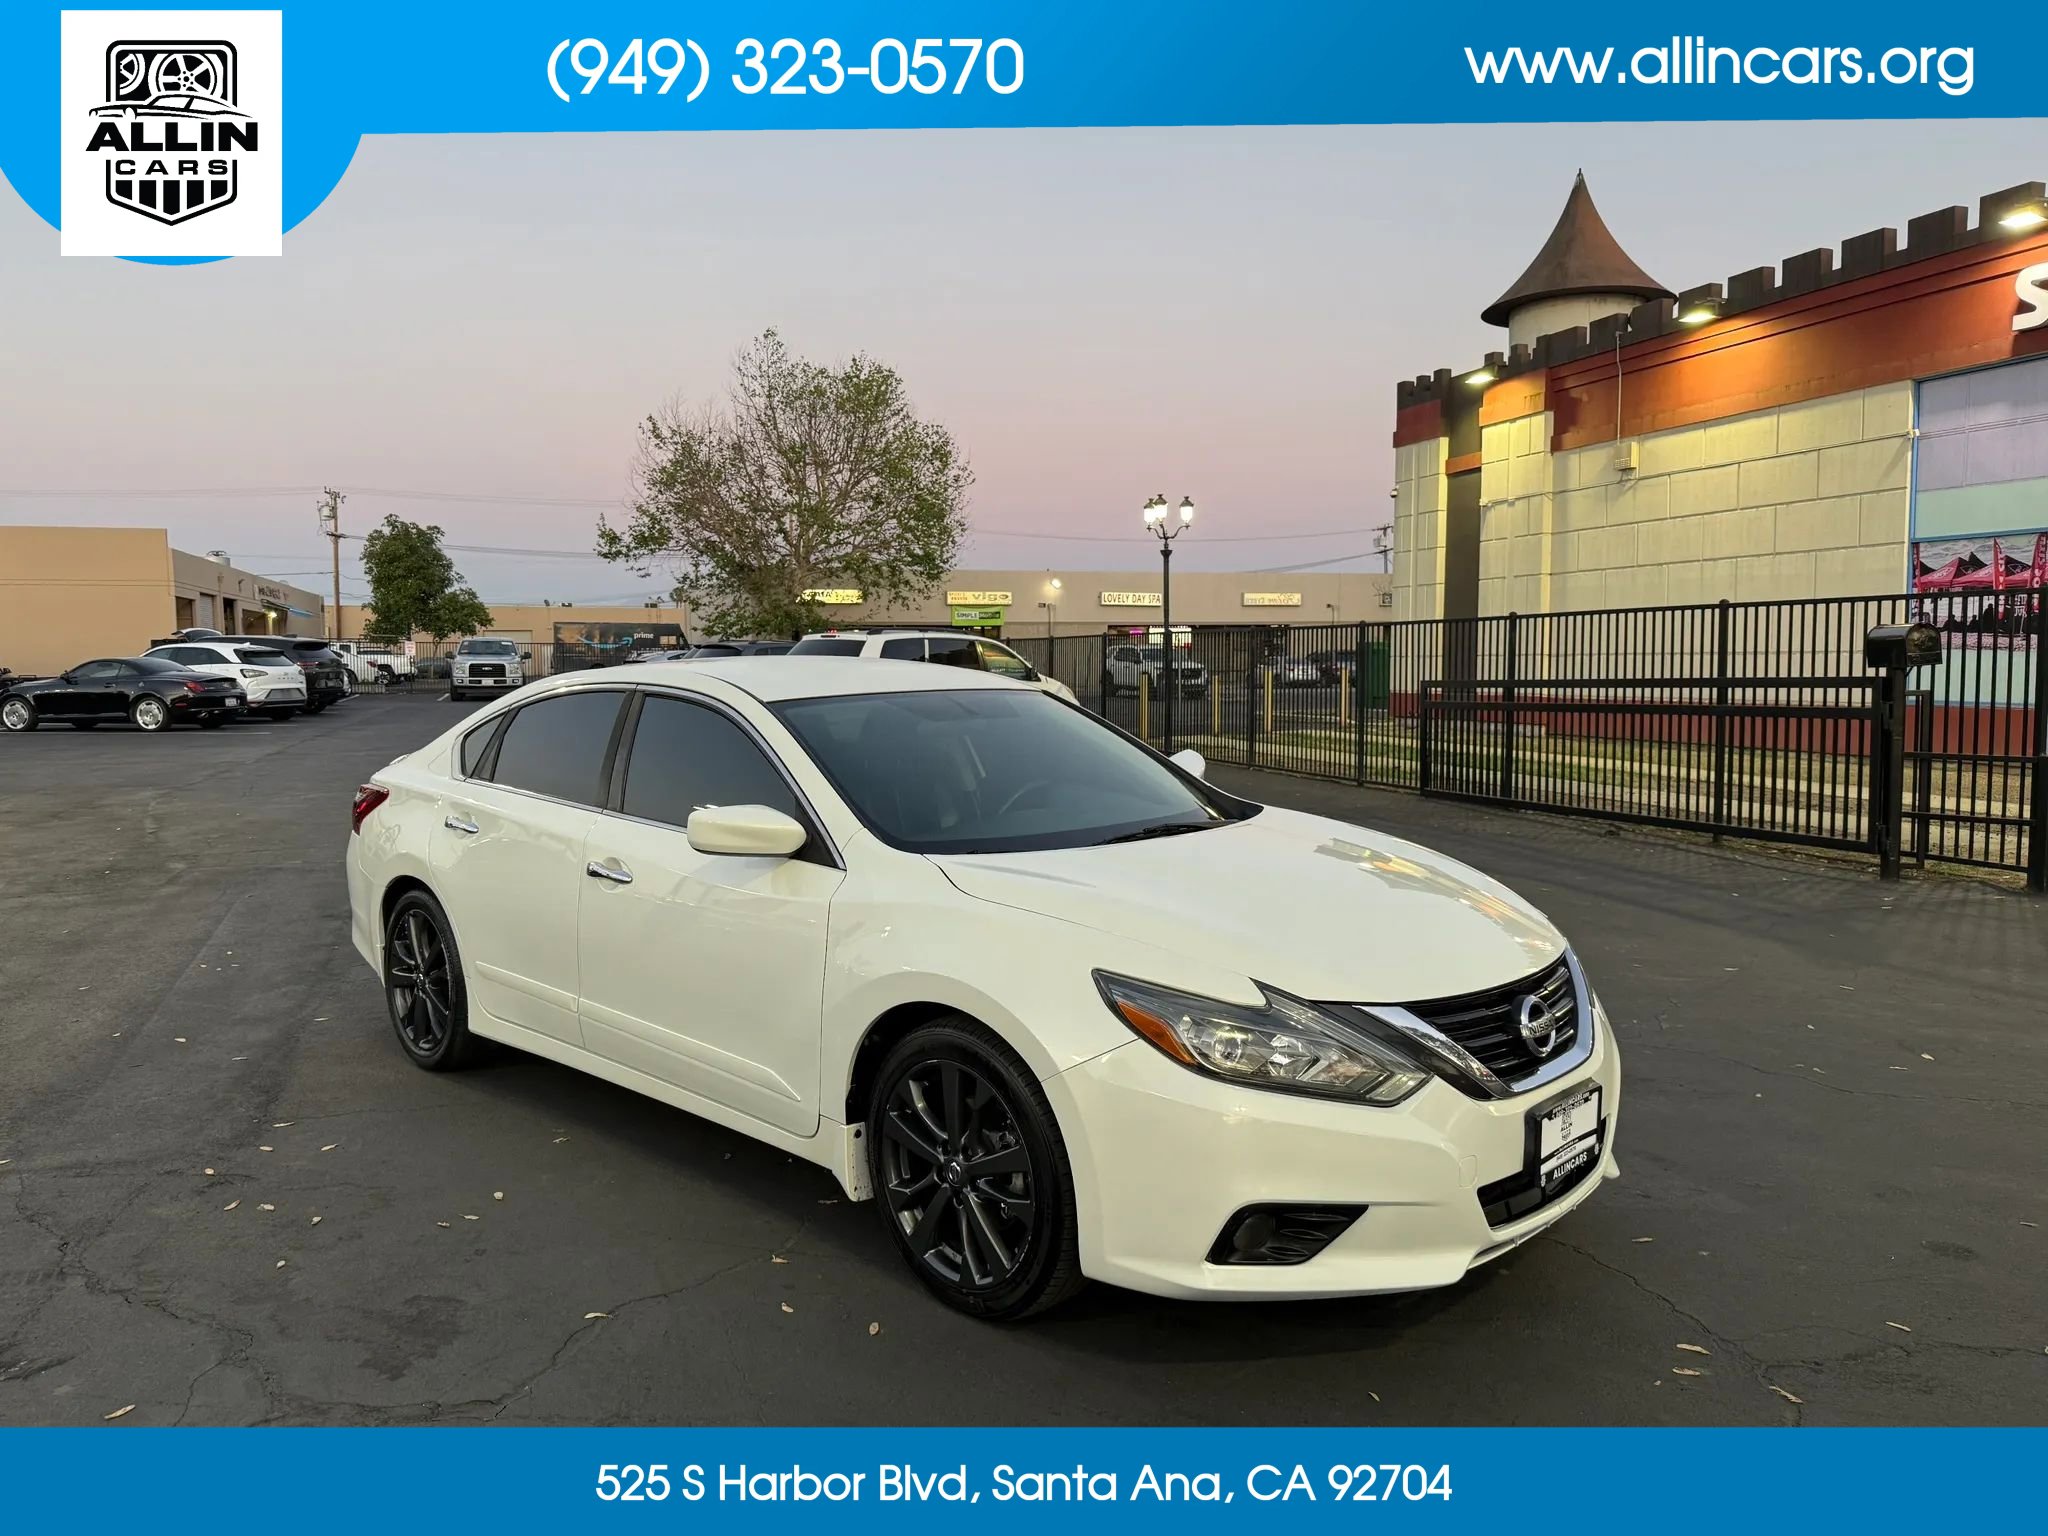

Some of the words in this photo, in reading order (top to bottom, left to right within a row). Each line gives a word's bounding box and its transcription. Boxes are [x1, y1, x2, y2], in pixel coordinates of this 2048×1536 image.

[972, 591, 1009, 602] vigo
[1103, 593, 1129, 603] LOVELY
[1132, 594, 1146, 603] DAY
[1148, 594, 1161, 604] SPA
[1553, 1151, 1588, 1179] ALLINCARS
